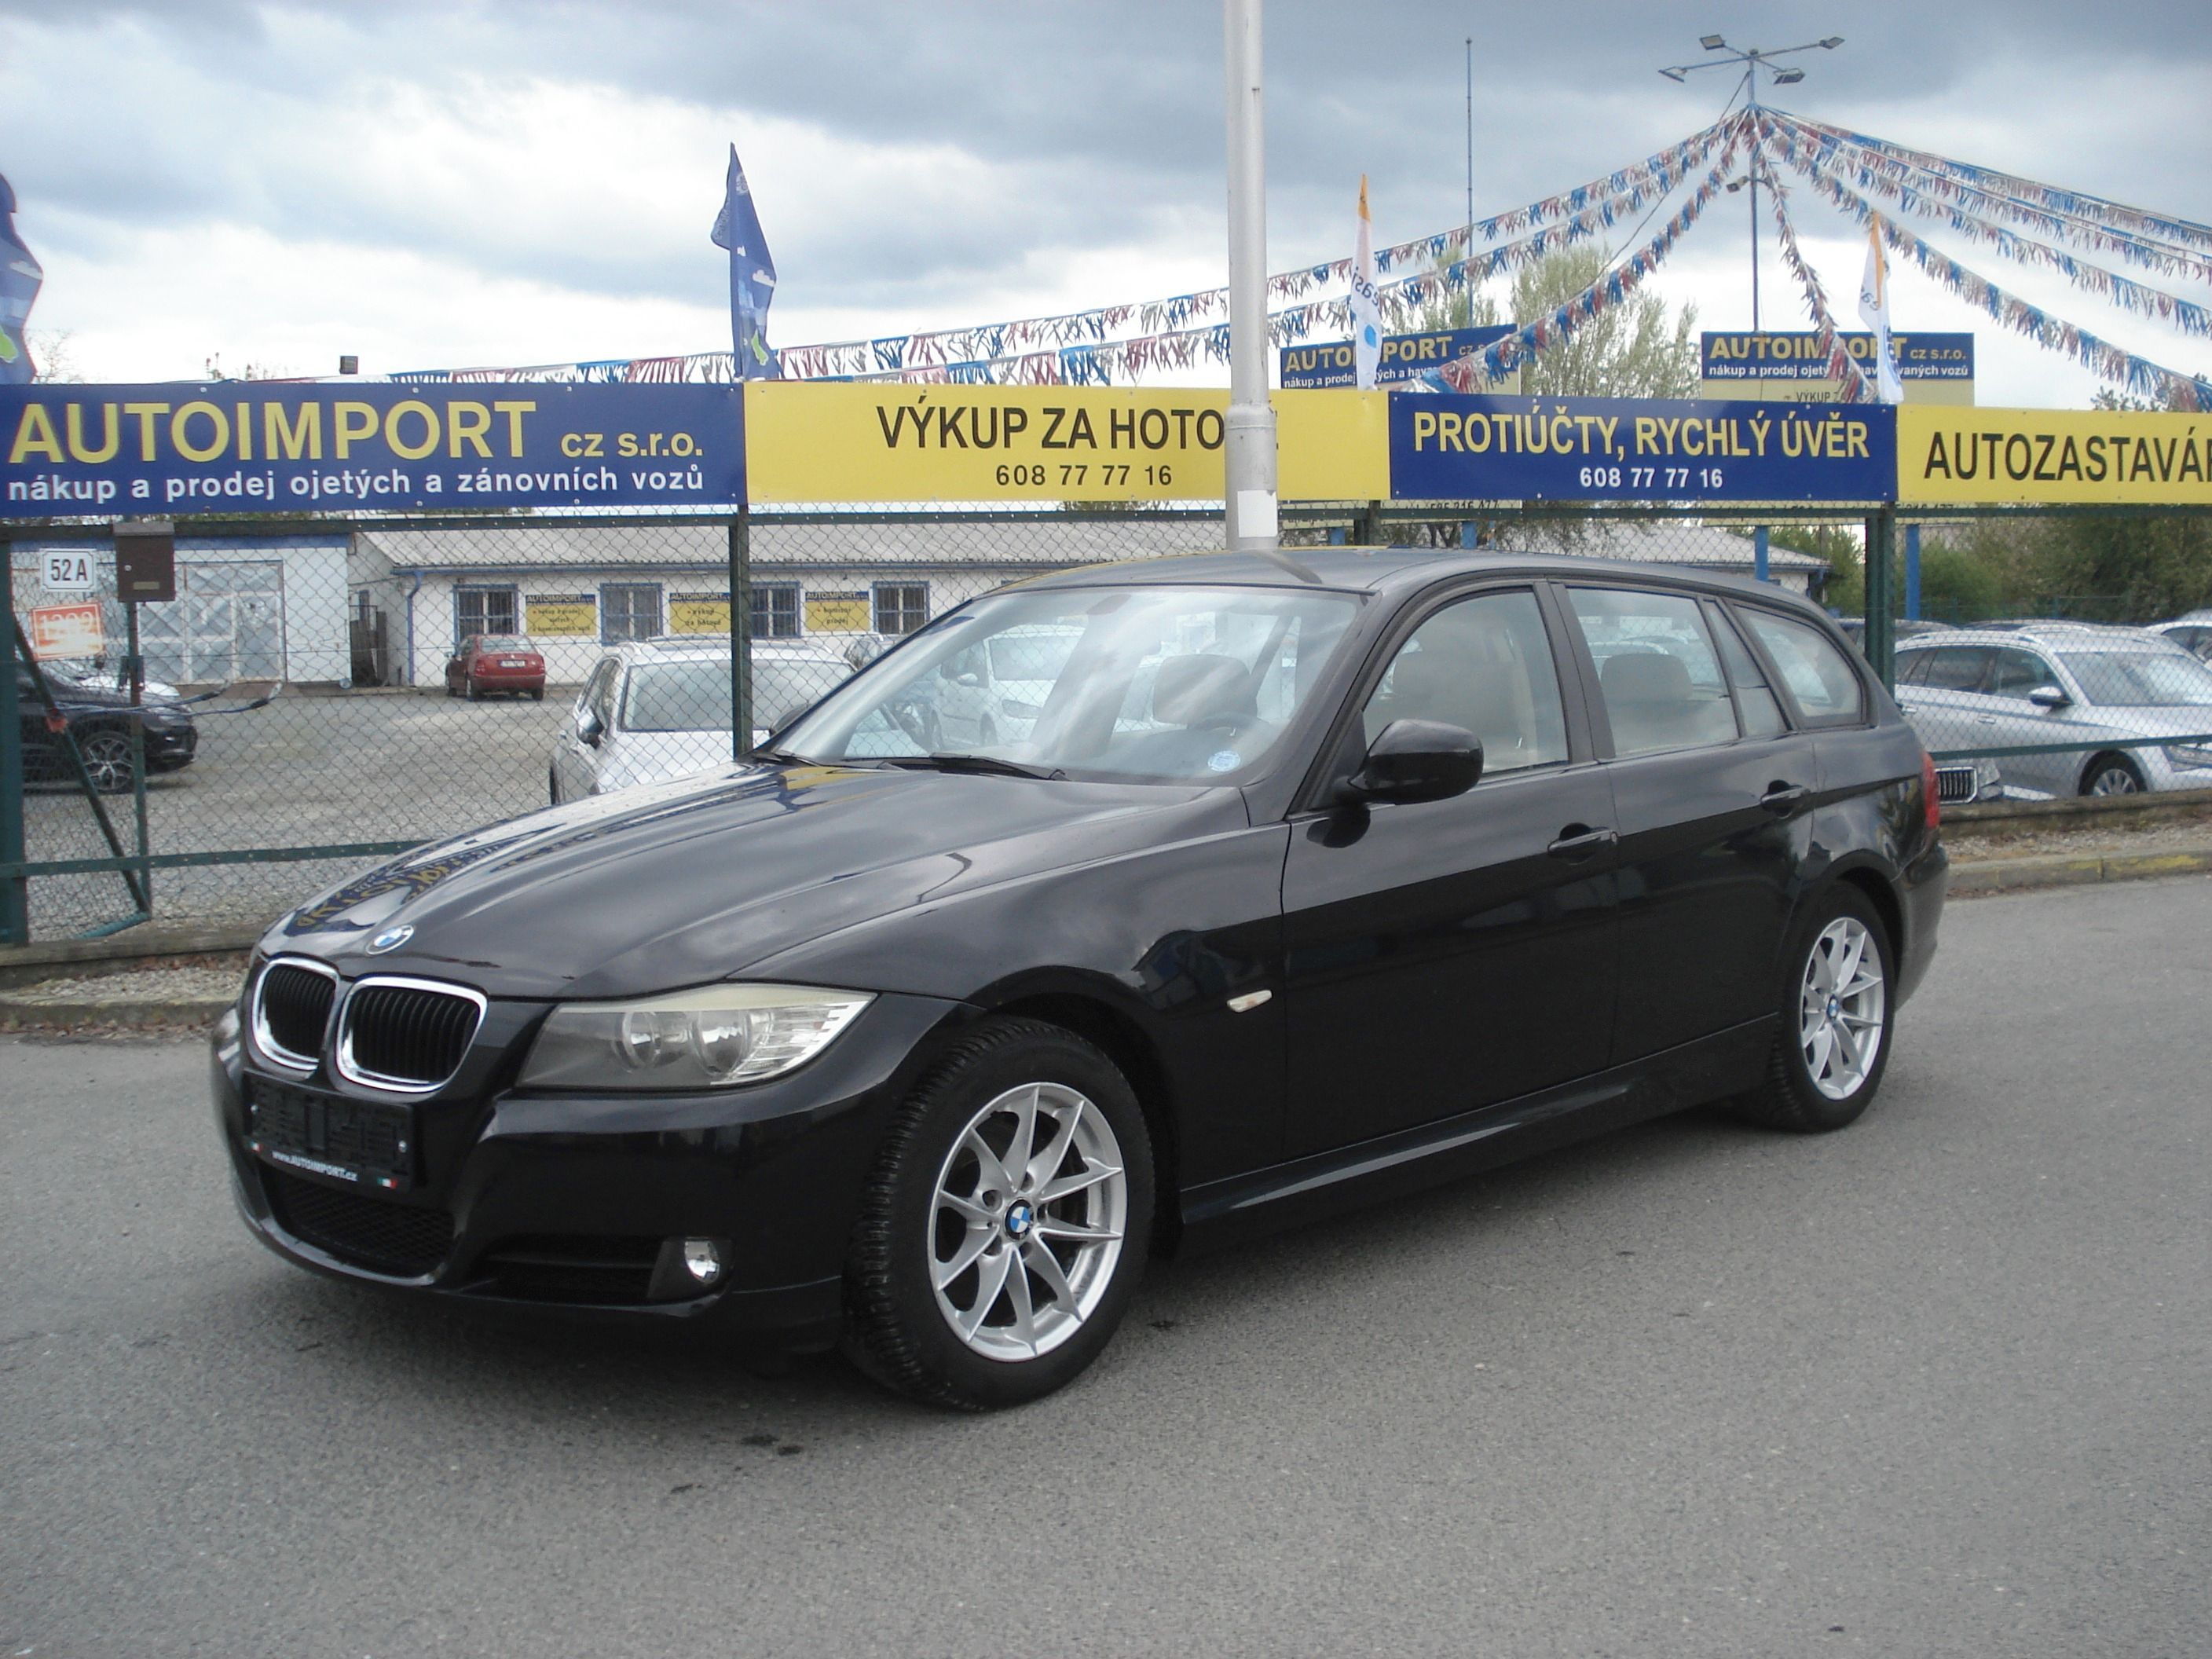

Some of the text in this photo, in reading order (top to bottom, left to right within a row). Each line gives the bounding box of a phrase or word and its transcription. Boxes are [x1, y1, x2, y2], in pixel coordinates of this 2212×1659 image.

[1284, 335, 1452, 373] AUTOIPORT
[1709, 336, 1907, 360] AUTOIMOT
[1284, 375, 1314, 389] nákup
[1325, 372, 1356, 386] prodej
[1709, 364, 1745, 378] nákup
[1749, 367, 1756, 375] a
[1760, 364, 1797, 378] prodej
[9, 400, 537, 463] AUTOIMPORT
[617, 432, 703, 457] s.r.o.
[877, 395, 1279, 450] VÝKUP ZA HOTO
[1415, 405, 1870, 462] PROTIÚČTY, RYCHLÝ ÚVĚR
[9, 463, 703, 504] nákup a prodej ojetých a zánovních vozů
[996, 465, 1172, 485] 608 77 77 16
[1580, 467, 1723, 488] 608 77 77 16
